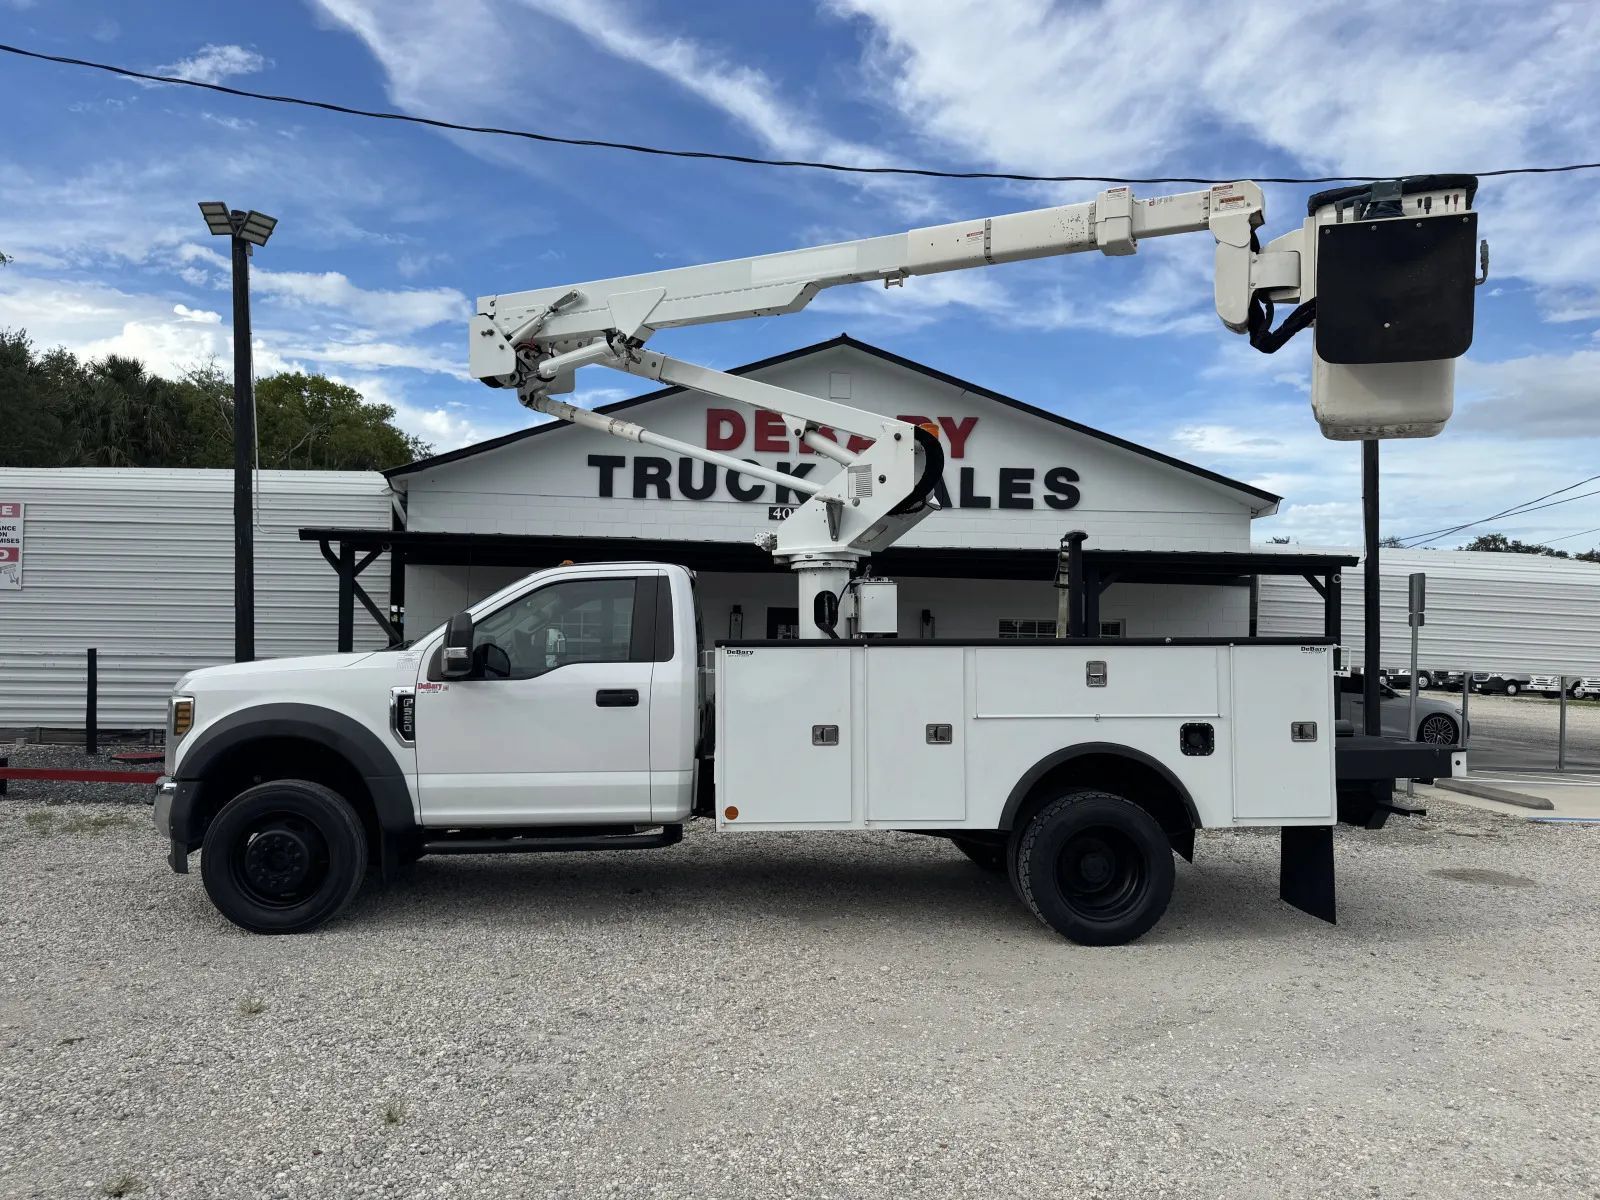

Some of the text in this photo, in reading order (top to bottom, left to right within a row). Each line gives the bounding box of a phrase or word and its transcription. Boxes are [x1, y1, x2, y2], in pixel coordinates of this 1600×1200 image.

[706, 408, 979, 458] DEY
[587, 454, 1081, 509] TRUCK LES
[417, 682, 442, 690] DeBary
